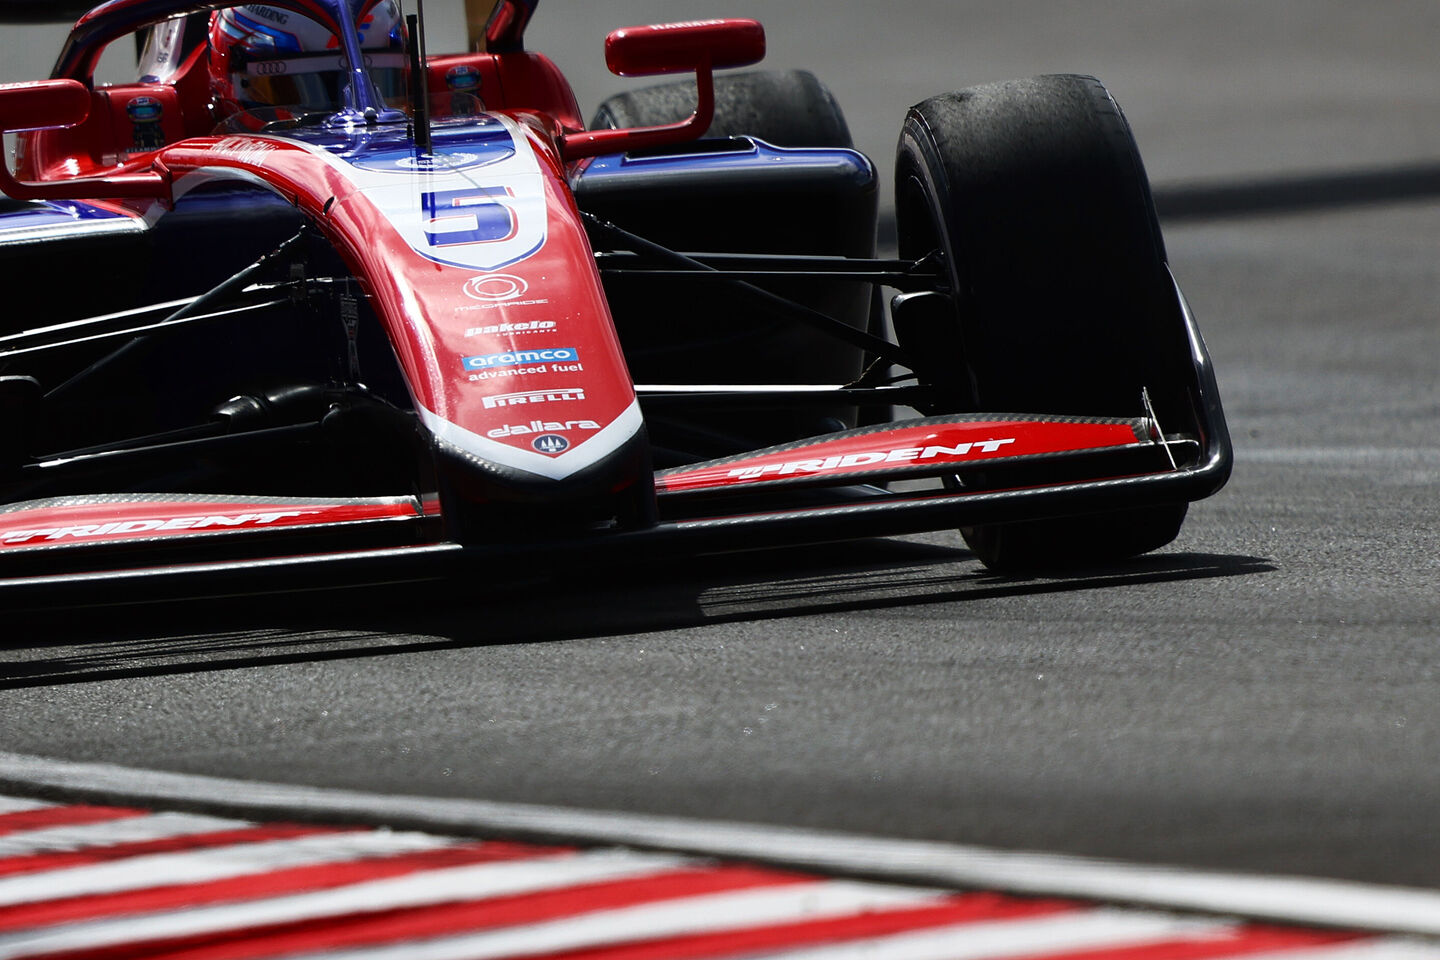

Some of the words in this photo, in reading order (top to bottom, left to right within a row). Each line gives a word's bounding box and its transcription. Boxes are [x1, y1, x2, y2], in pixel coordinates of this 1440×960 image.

[421, 186, 516, 247] 5
[464, 320, 557, 338] pakelo
[468, 350, 572, 368] aramco
[468, 364, 548, 382] advanced
[551, 363, 584, 373] fuel
[481, 388, 586, 409] PIRELLI
[487, 420, 602, 438] dallara
[726, 438, 1016, 480] TRIDENT
